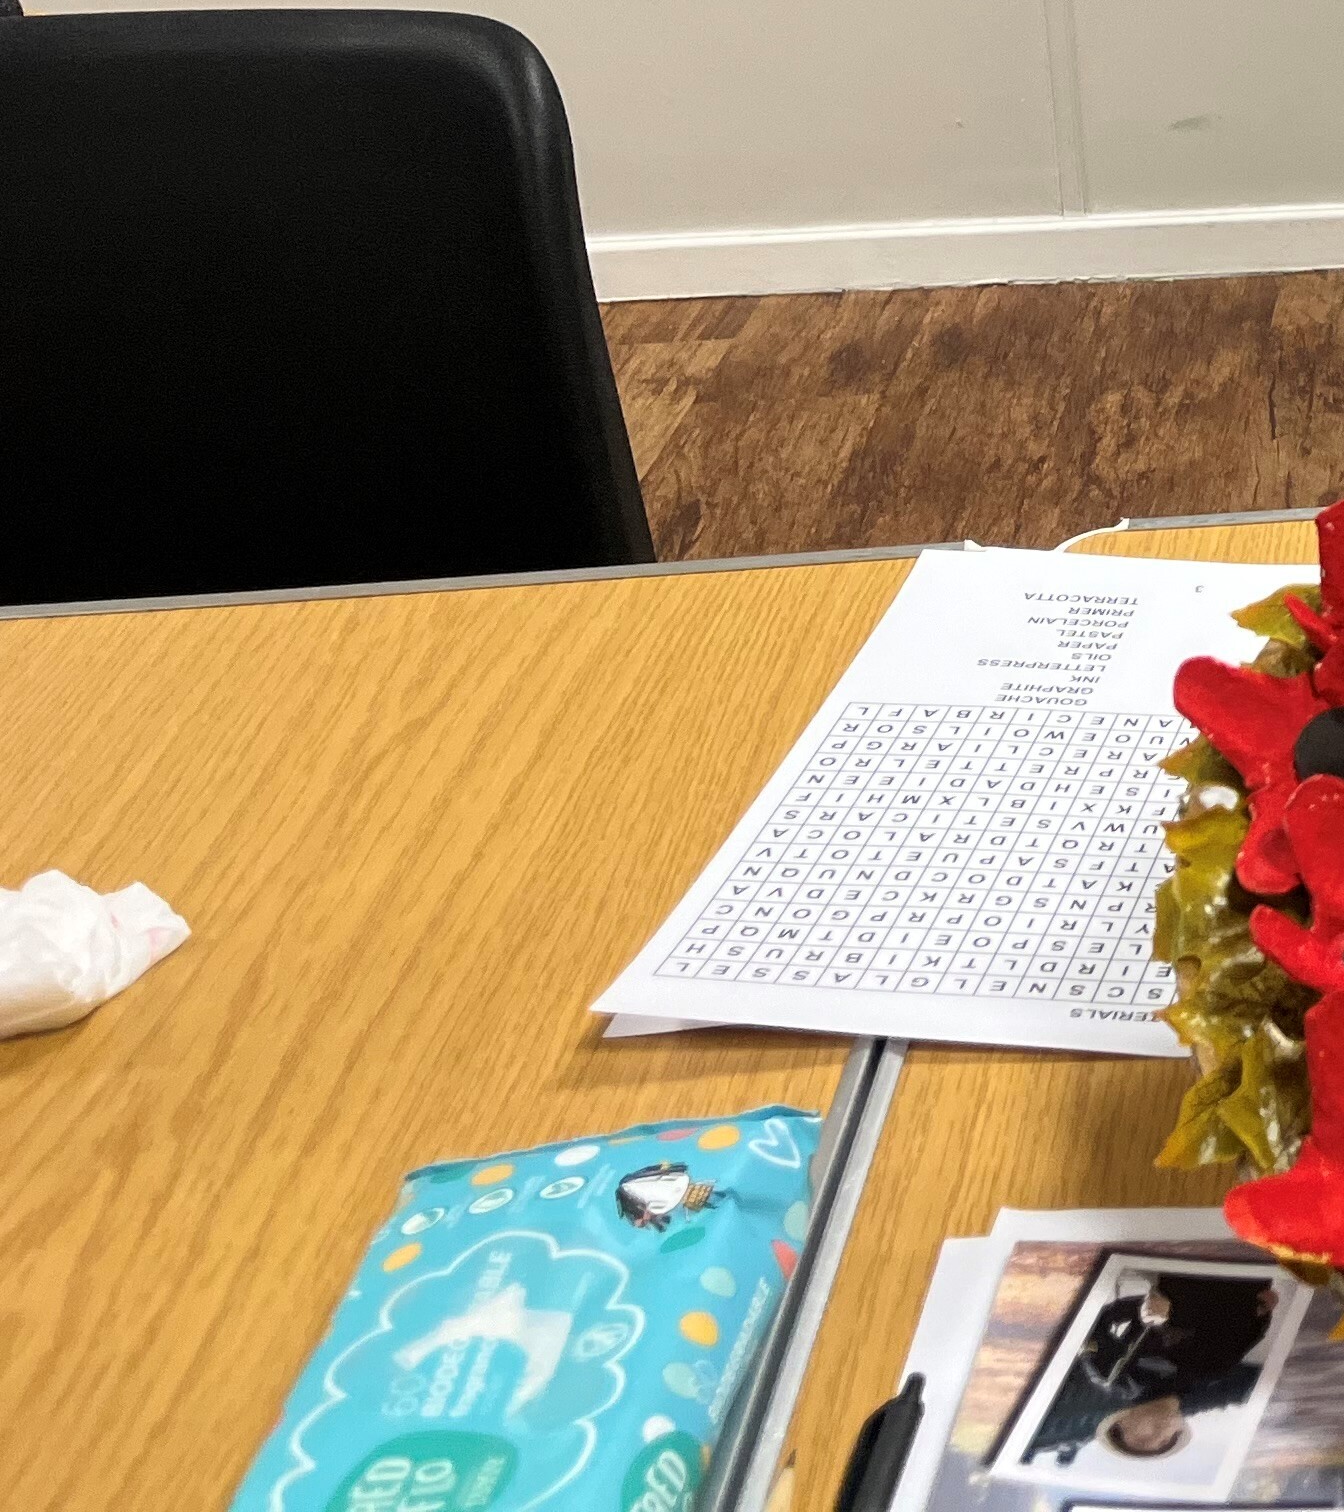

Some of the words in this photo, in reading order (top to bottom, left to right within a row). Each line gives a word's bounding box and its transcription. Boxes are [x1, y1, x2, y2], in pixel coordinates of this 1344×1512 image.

[1024, 592, 1140, 606] TERRACOTTA
[1068, 606, 1135, 618] PRIMER
[1027, 616, 1129, 629] PORCELAIN
[1055, 629, 1124, 640] PASTEL
[1057, 640, 1119, 651] PAPER
[1071, 652, 1112, 662] OILS
[976, 658, 1107, 673] LETTERPRESS
[1069, 674, 1101, 685] INK
[999, 682, 1095, 696] GRAPHITE
[993, 693, 1088, 707] GOUACHE
